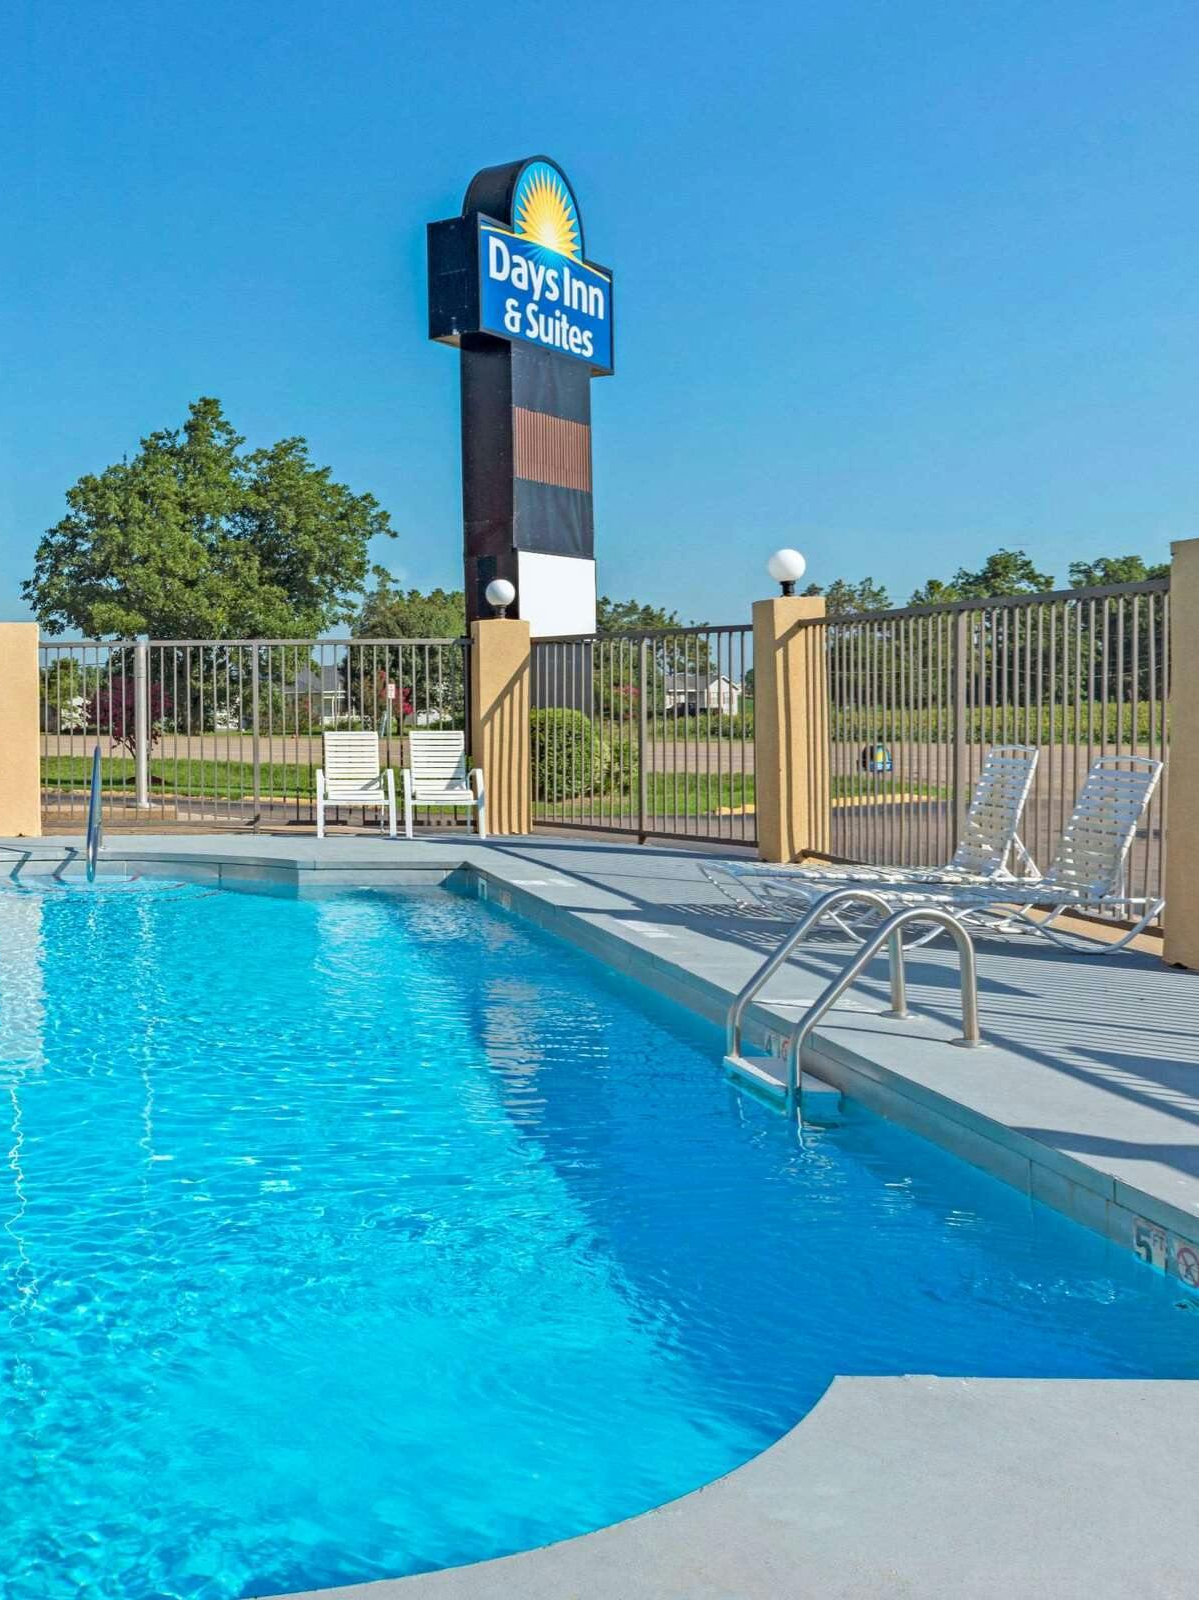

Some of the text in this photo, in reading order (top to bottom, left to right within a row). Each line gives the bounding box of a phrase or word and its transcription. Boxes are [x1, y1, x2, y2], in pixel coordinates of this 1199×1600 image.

[488, 236, 605, 320] Days Inn
[504, 298, 594, 358] & Suites
[1136, 1225, 1165, 1264] 5 FT
